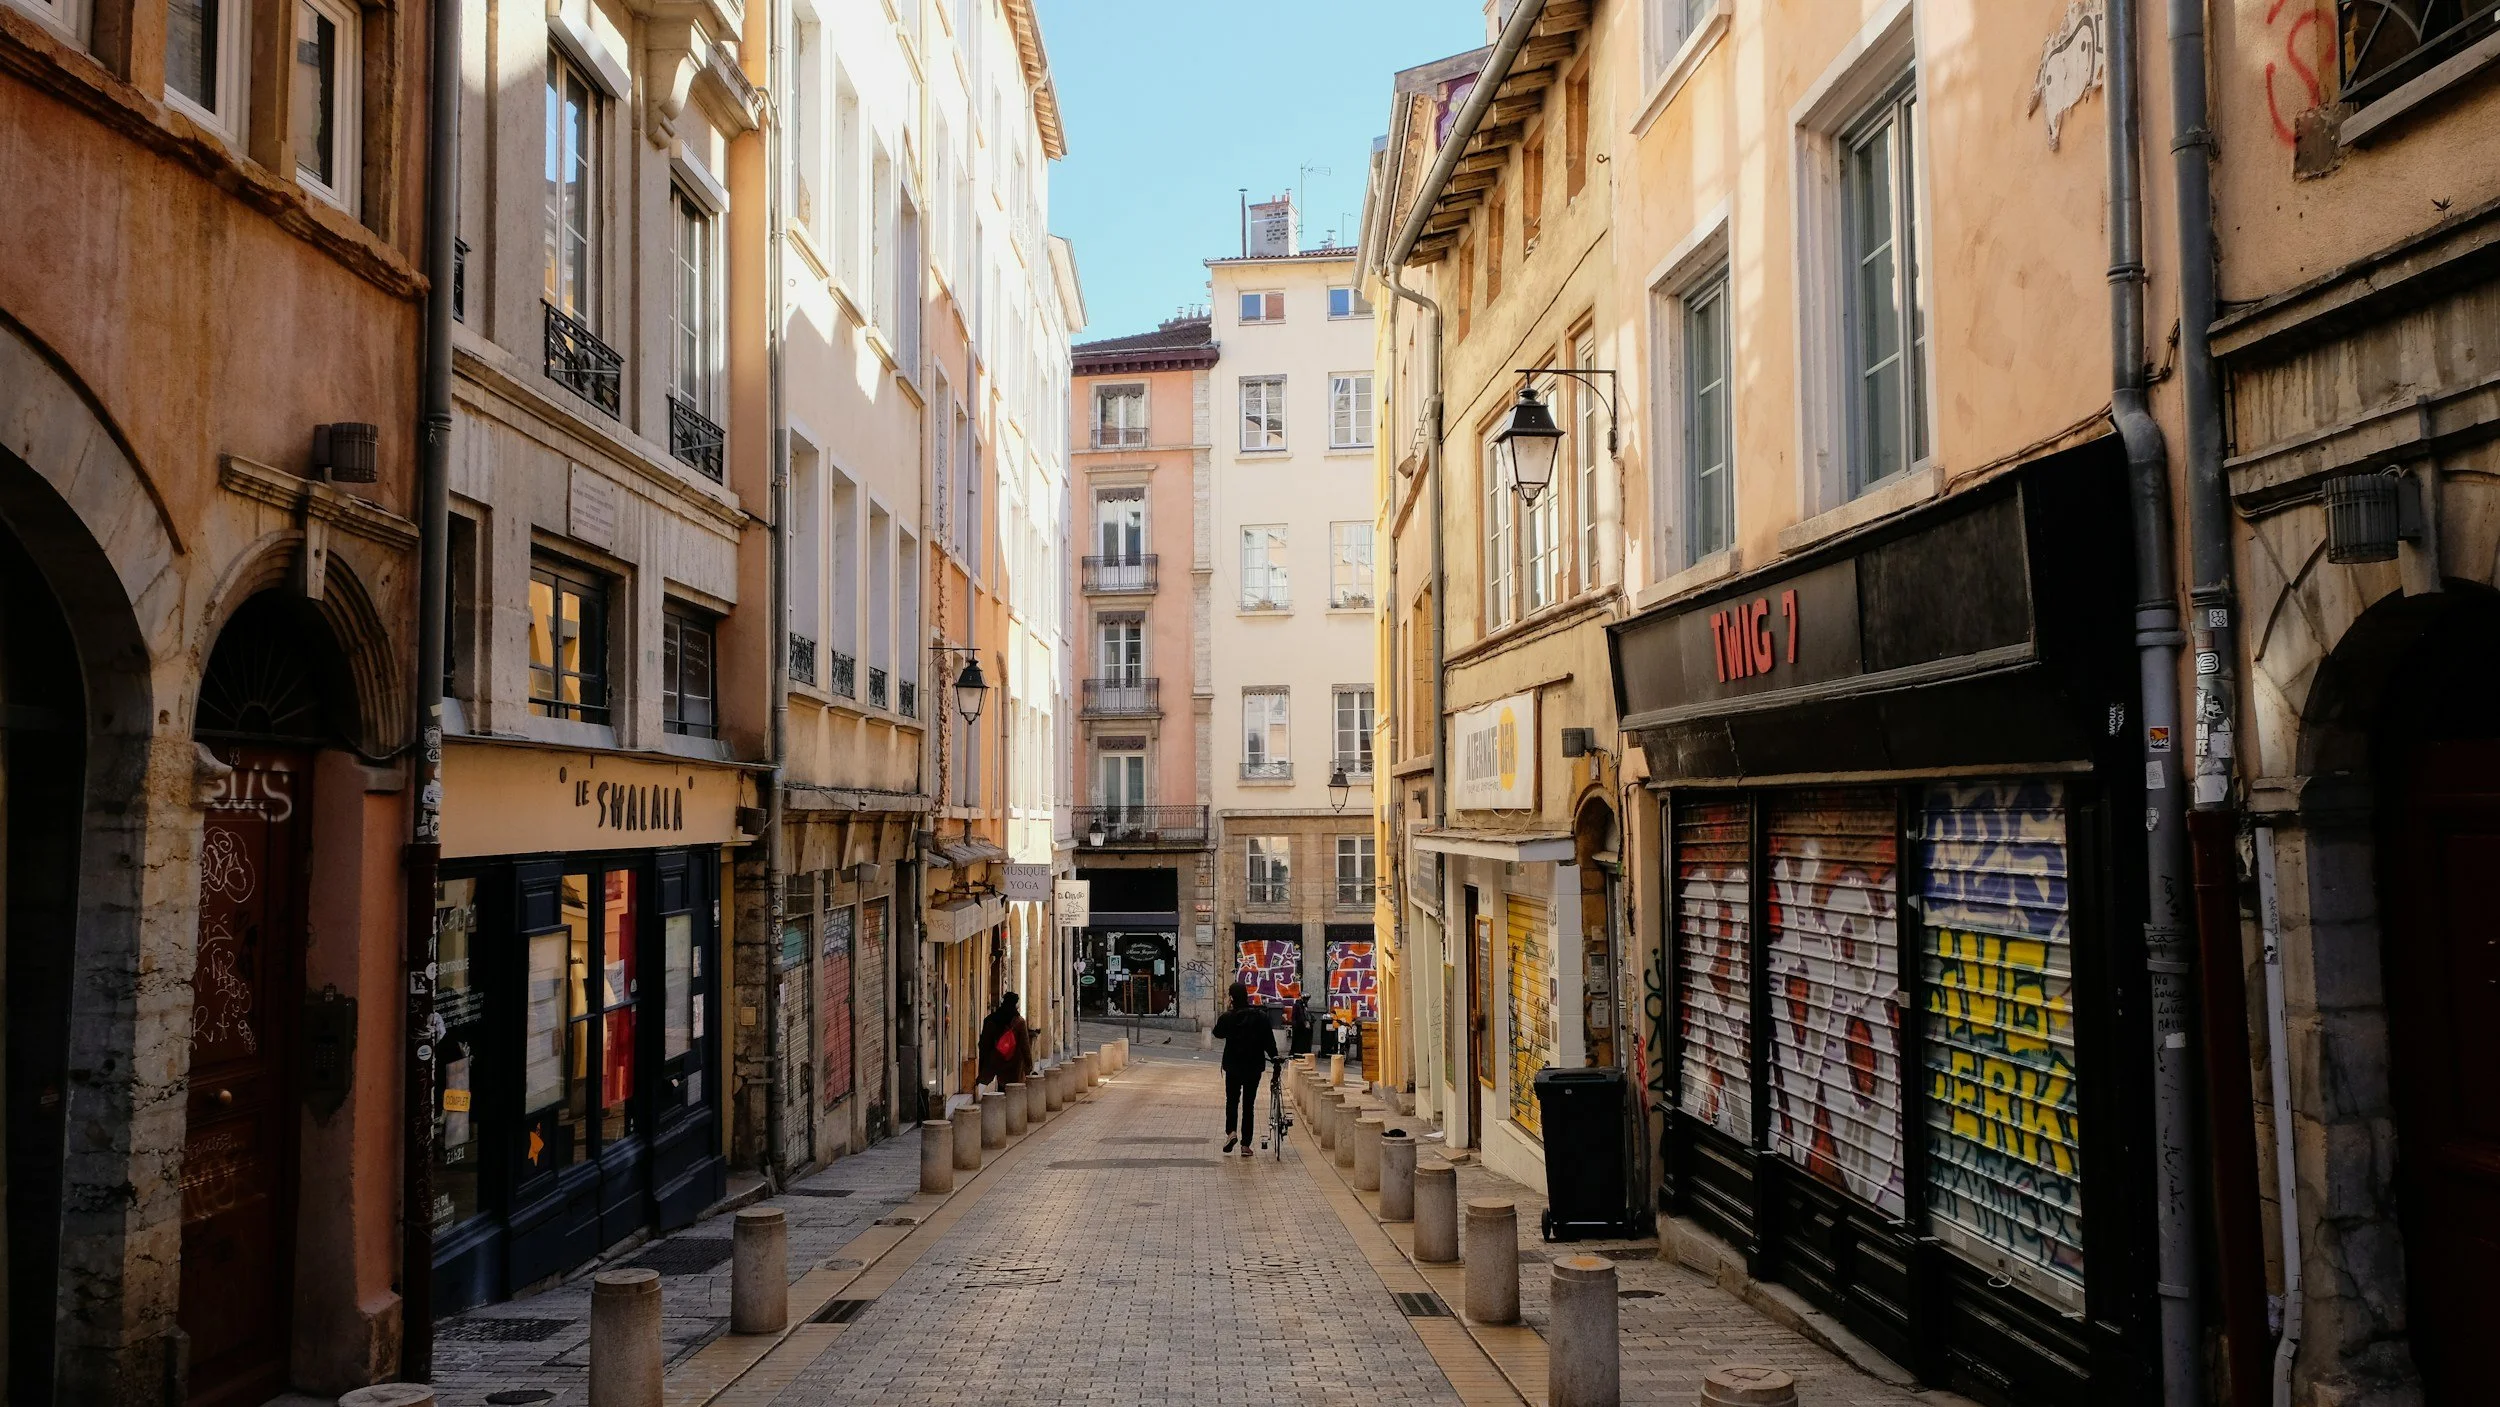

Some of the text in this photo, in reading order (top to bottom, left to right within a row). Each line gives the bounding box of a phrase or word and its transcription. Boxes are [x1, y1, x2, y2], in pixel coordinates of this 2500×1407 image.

[1711, 598, 1773, 683] TWIG
[575, 780, 683, 831] LE SHALALA
[1002, 867, 1047, 877] MUSIQUE
[1010, 881, 1039, 890] YOGA
[445, 1095, 469, 1107] COMPLET
